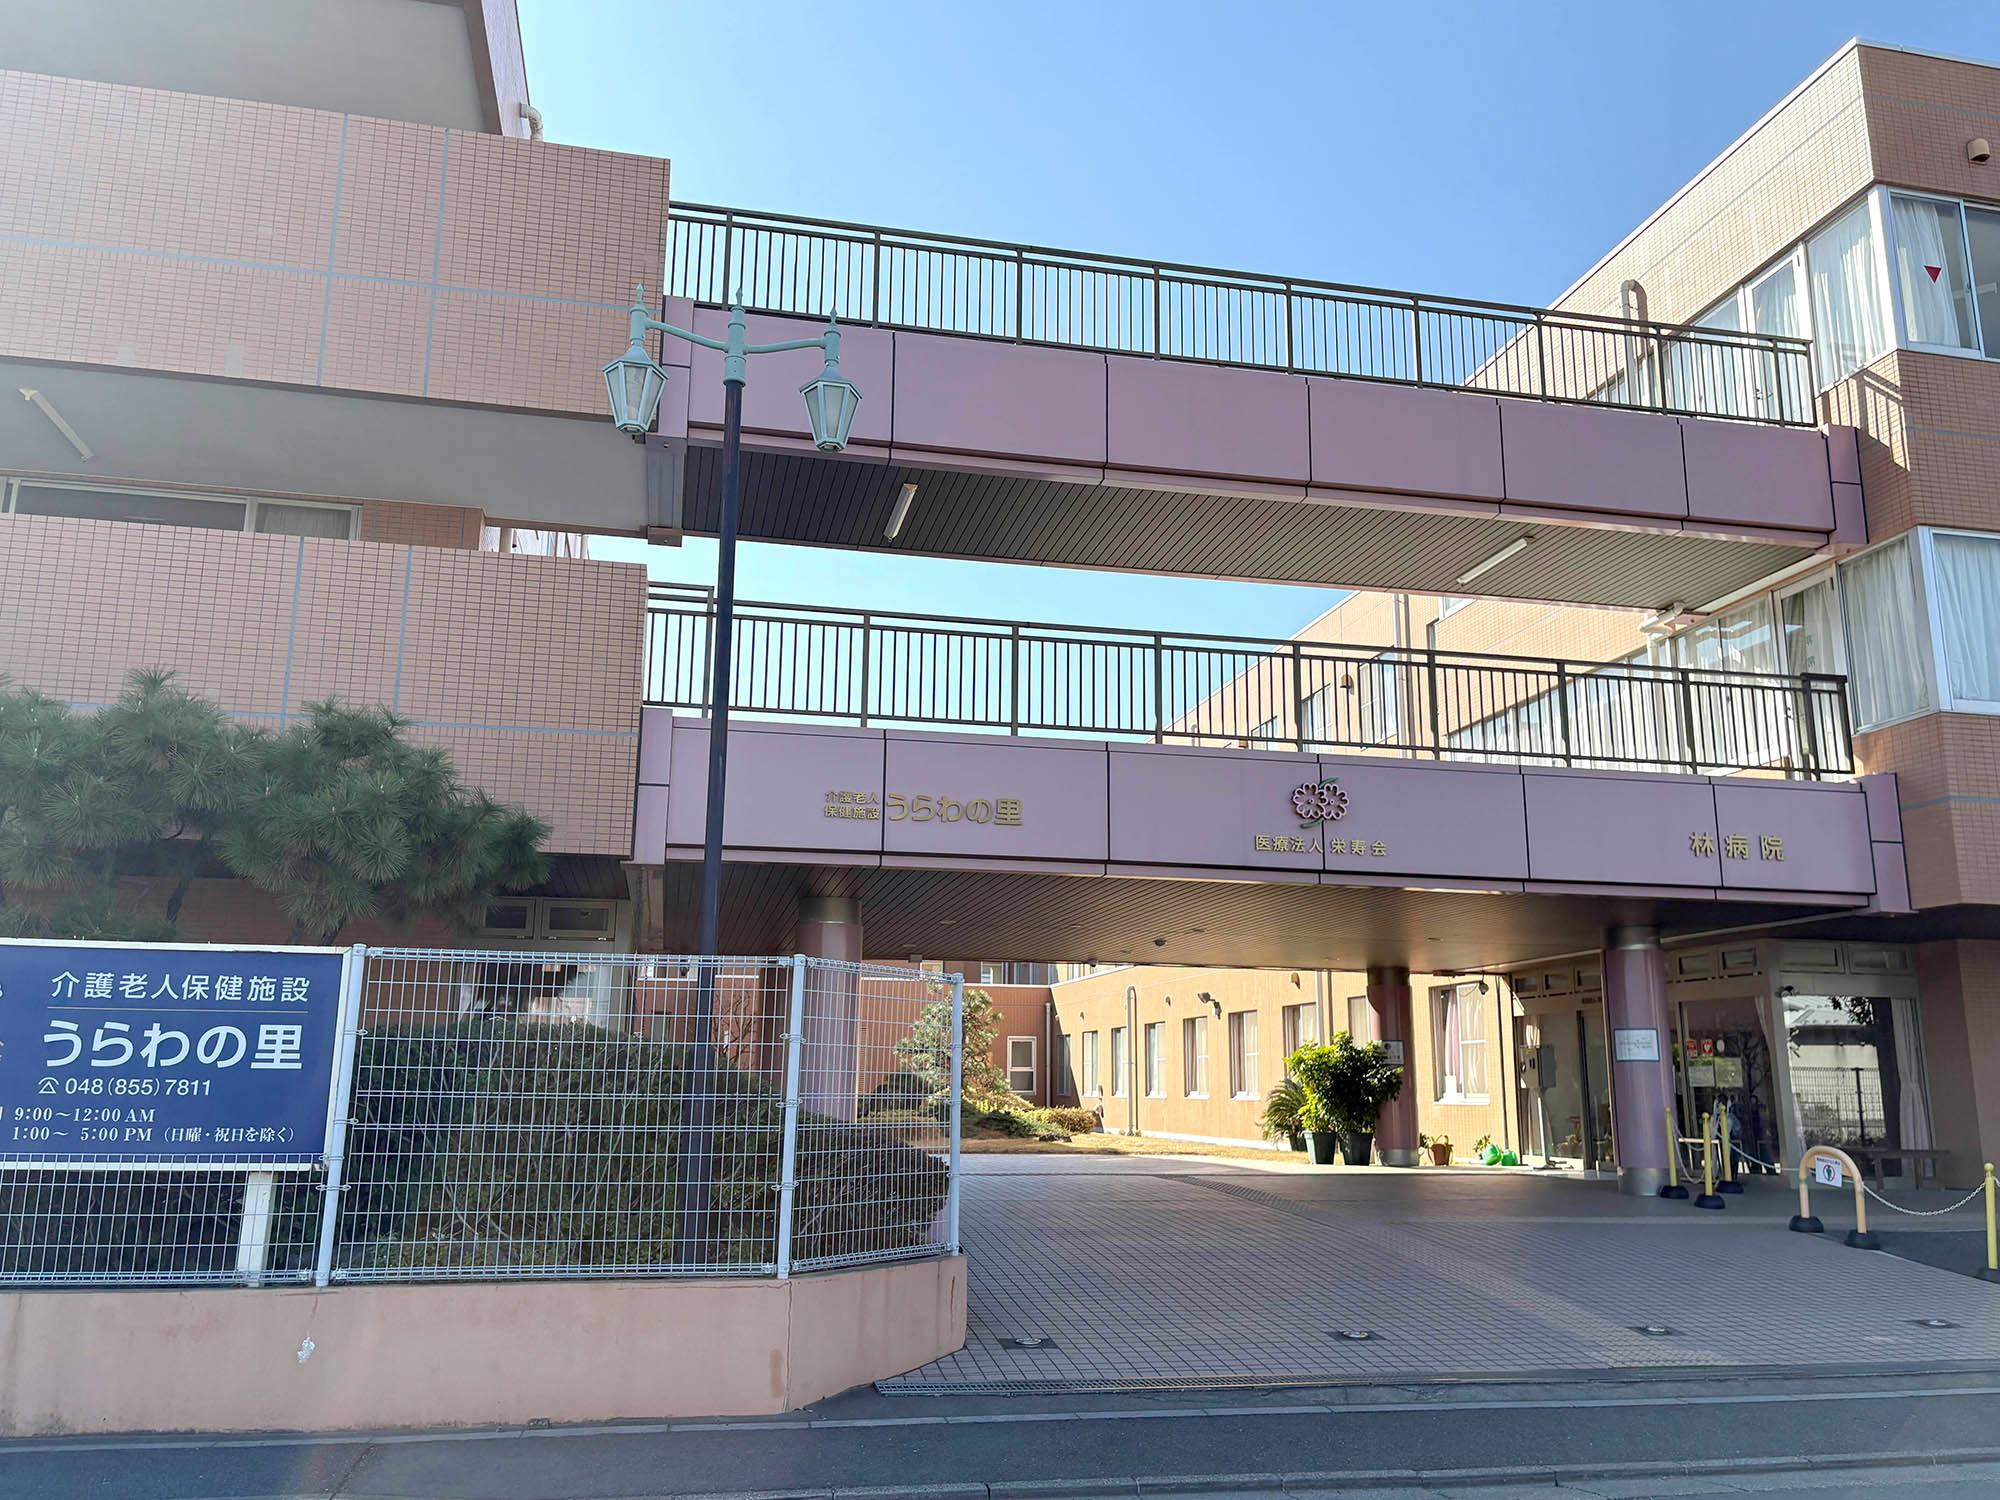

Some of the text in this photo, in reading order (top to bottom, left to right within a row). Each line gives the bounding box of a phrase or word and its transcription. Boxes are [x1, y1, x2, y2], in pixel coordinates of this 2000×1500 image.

[824, 791, 879, 804] 介護老人
[824, 805, 880, 820] 保健施設
[886, 793, 1022, 825] うらわの里
[1689, 832, 1784, 861] 林病院
[51, 971, 310, 1003] 介護老人保健施設
[43, 1019, 303, 1070] うらわの里
[65, 1077, 212, 1096] 048(855)7811
[124, 1109, 156, 1122] AM
[124, 1129, 152, 1142] PM
